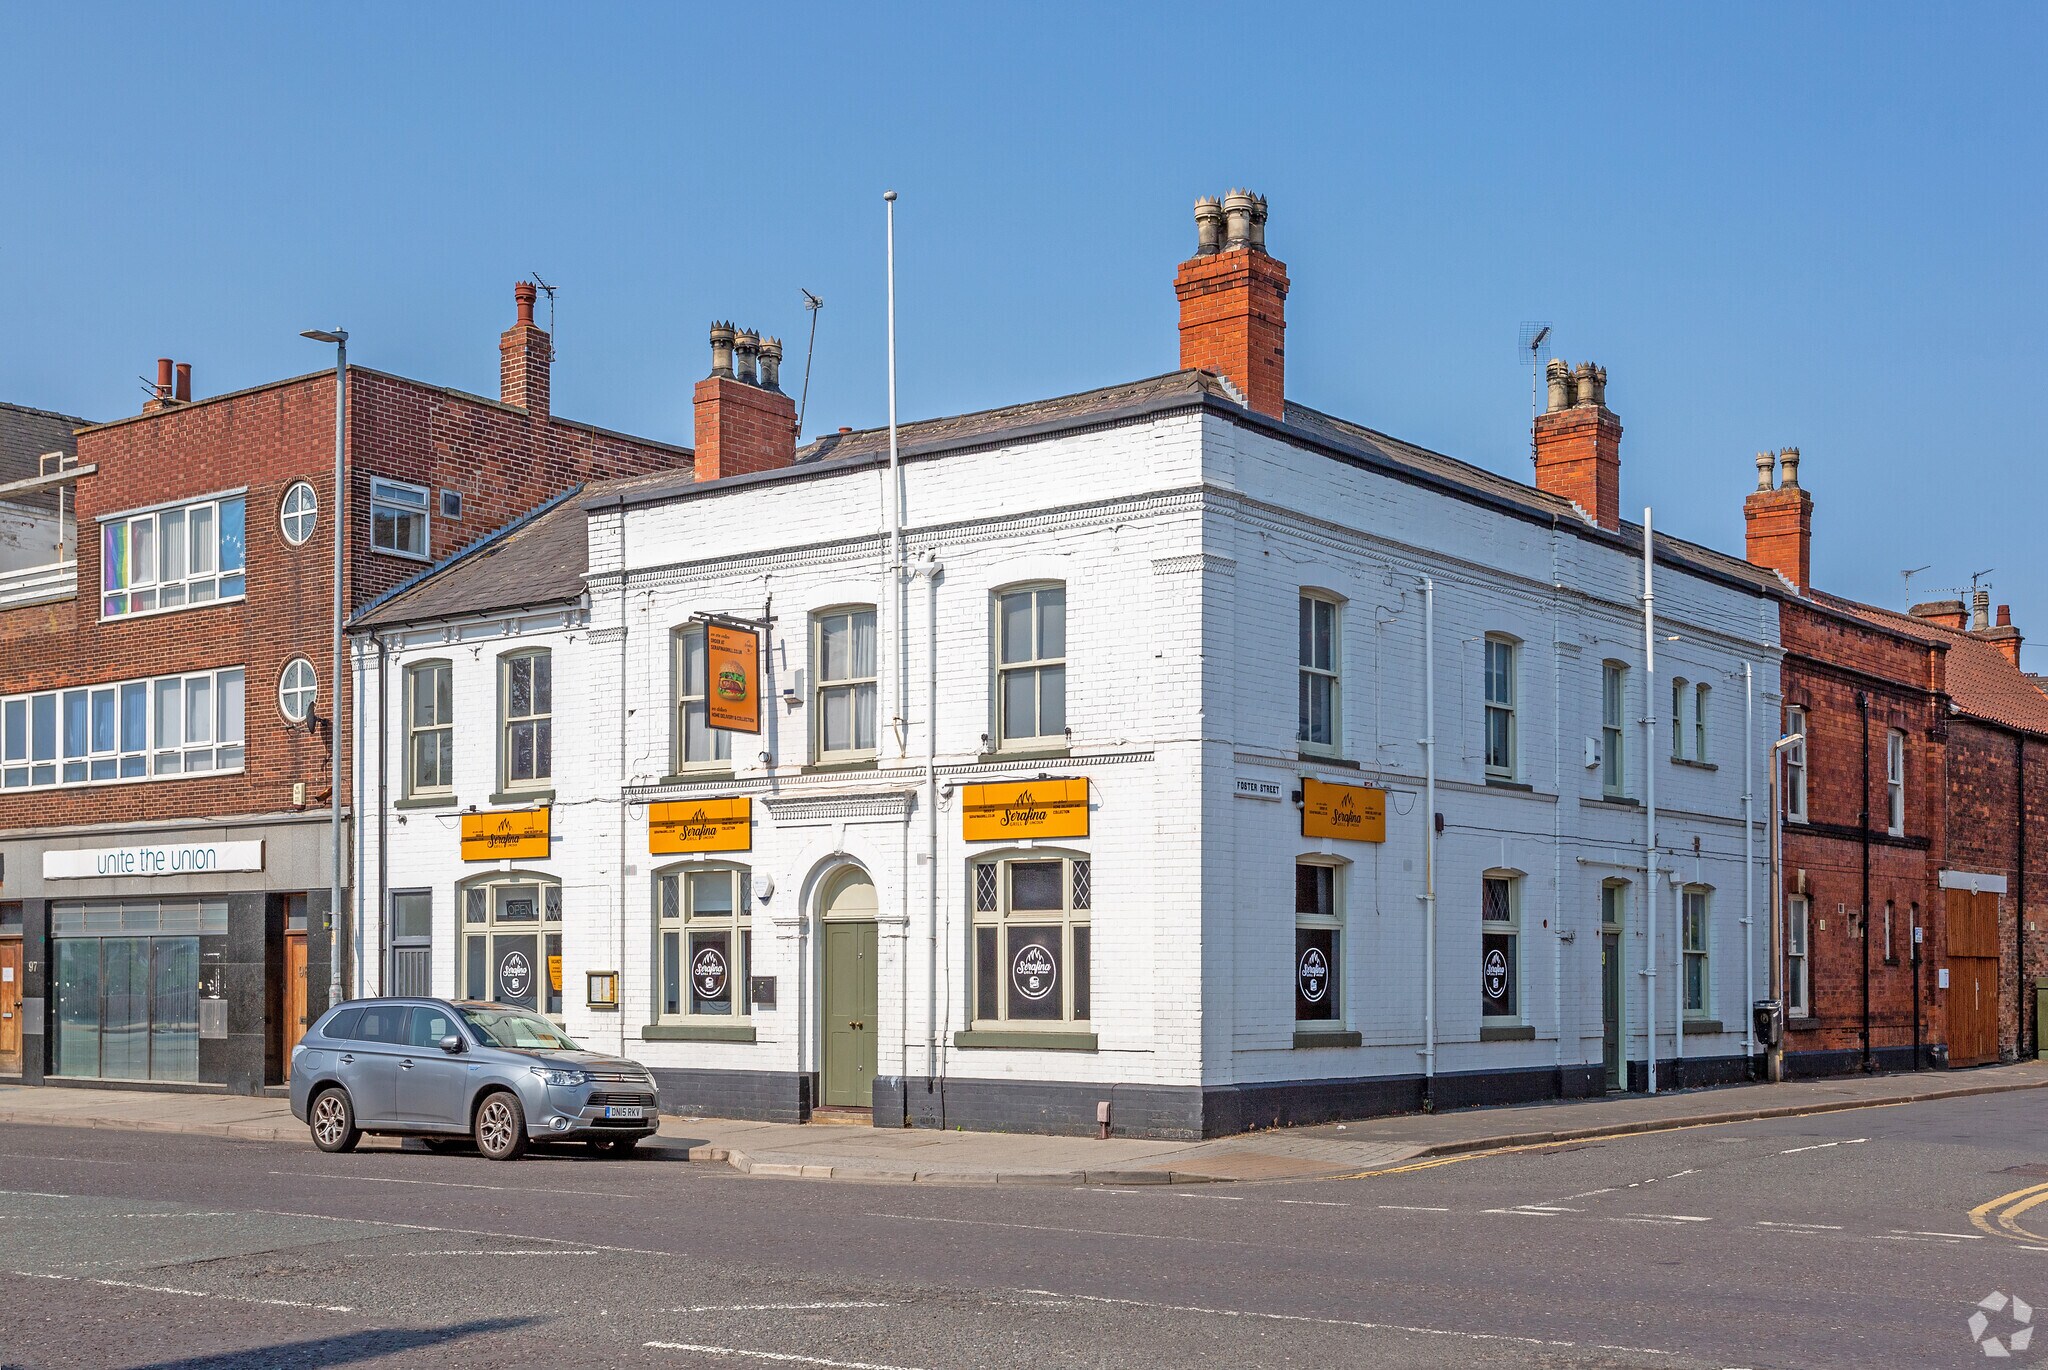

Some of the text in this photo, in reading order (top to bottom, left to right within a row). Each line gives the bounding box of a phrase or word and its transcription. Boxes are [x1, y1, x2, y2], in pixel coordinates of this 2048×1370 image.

[1236, 781, 1279, 794] FOSTER STREET
[1000, 807, 1047, 826] Serafina
[1331, 809, 1361, 827] Serafina
[679, 824, 716, 840] Serafina
[487, 832, 520, 848] Serafina
[97, 848, 216, 874] unite the union
[508, 905, 531, 915] OPEN
[29, 961, 38, 972] 97
[1017, 960, 1051, 974] Serafina
[628, 1108, 640, 1116] RKV
